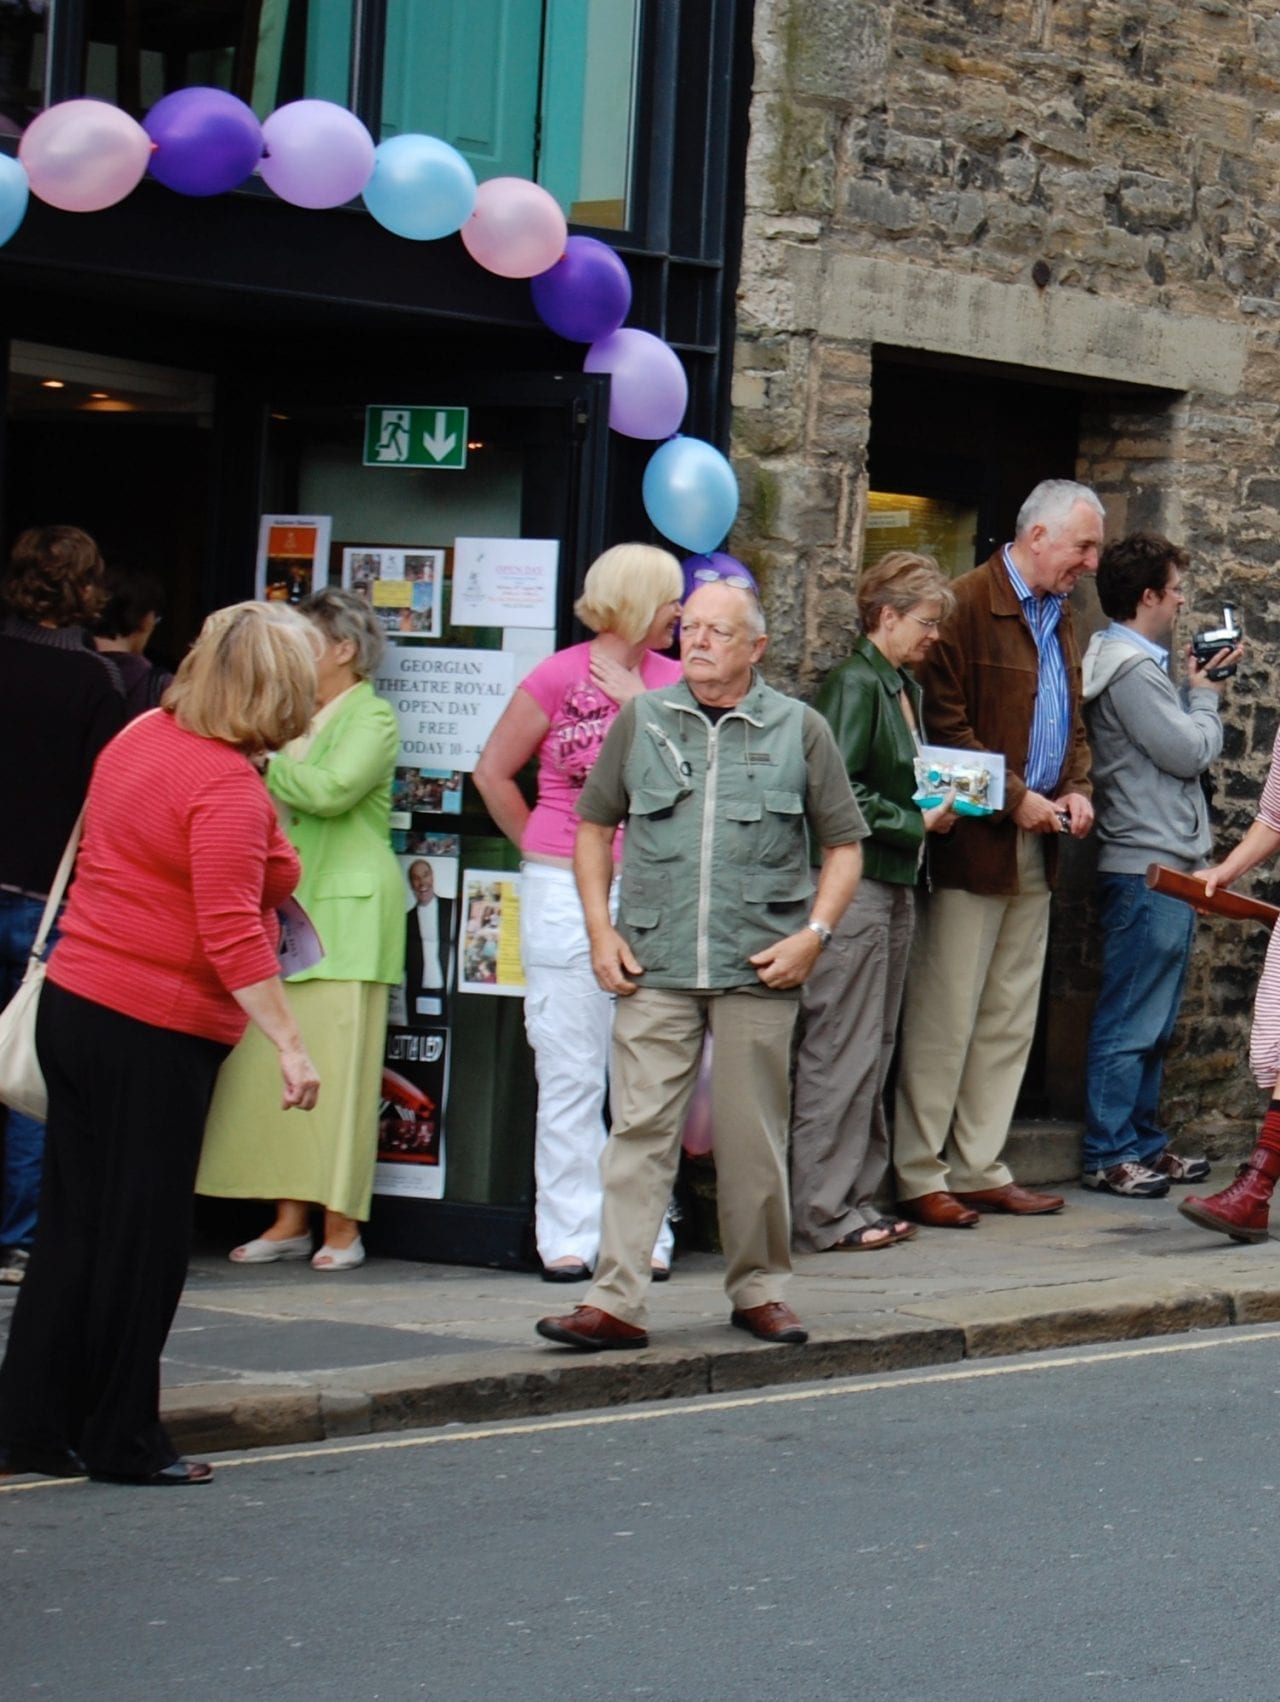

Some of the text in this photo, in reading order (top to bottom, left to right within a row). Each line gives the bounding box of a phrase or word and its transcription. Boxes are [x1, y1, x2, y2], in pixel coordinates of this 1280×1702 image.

[400, 658, 482, 674] GEORGIAN
[376, 678, 505, 696] THEATRE ROYAL
[398, 699, 480, 716] OPEN DAY
[418, 721, 458, 735] FREE
[400, 740, 446, 755] ODAY
[450, 742, 463, 755] 10
